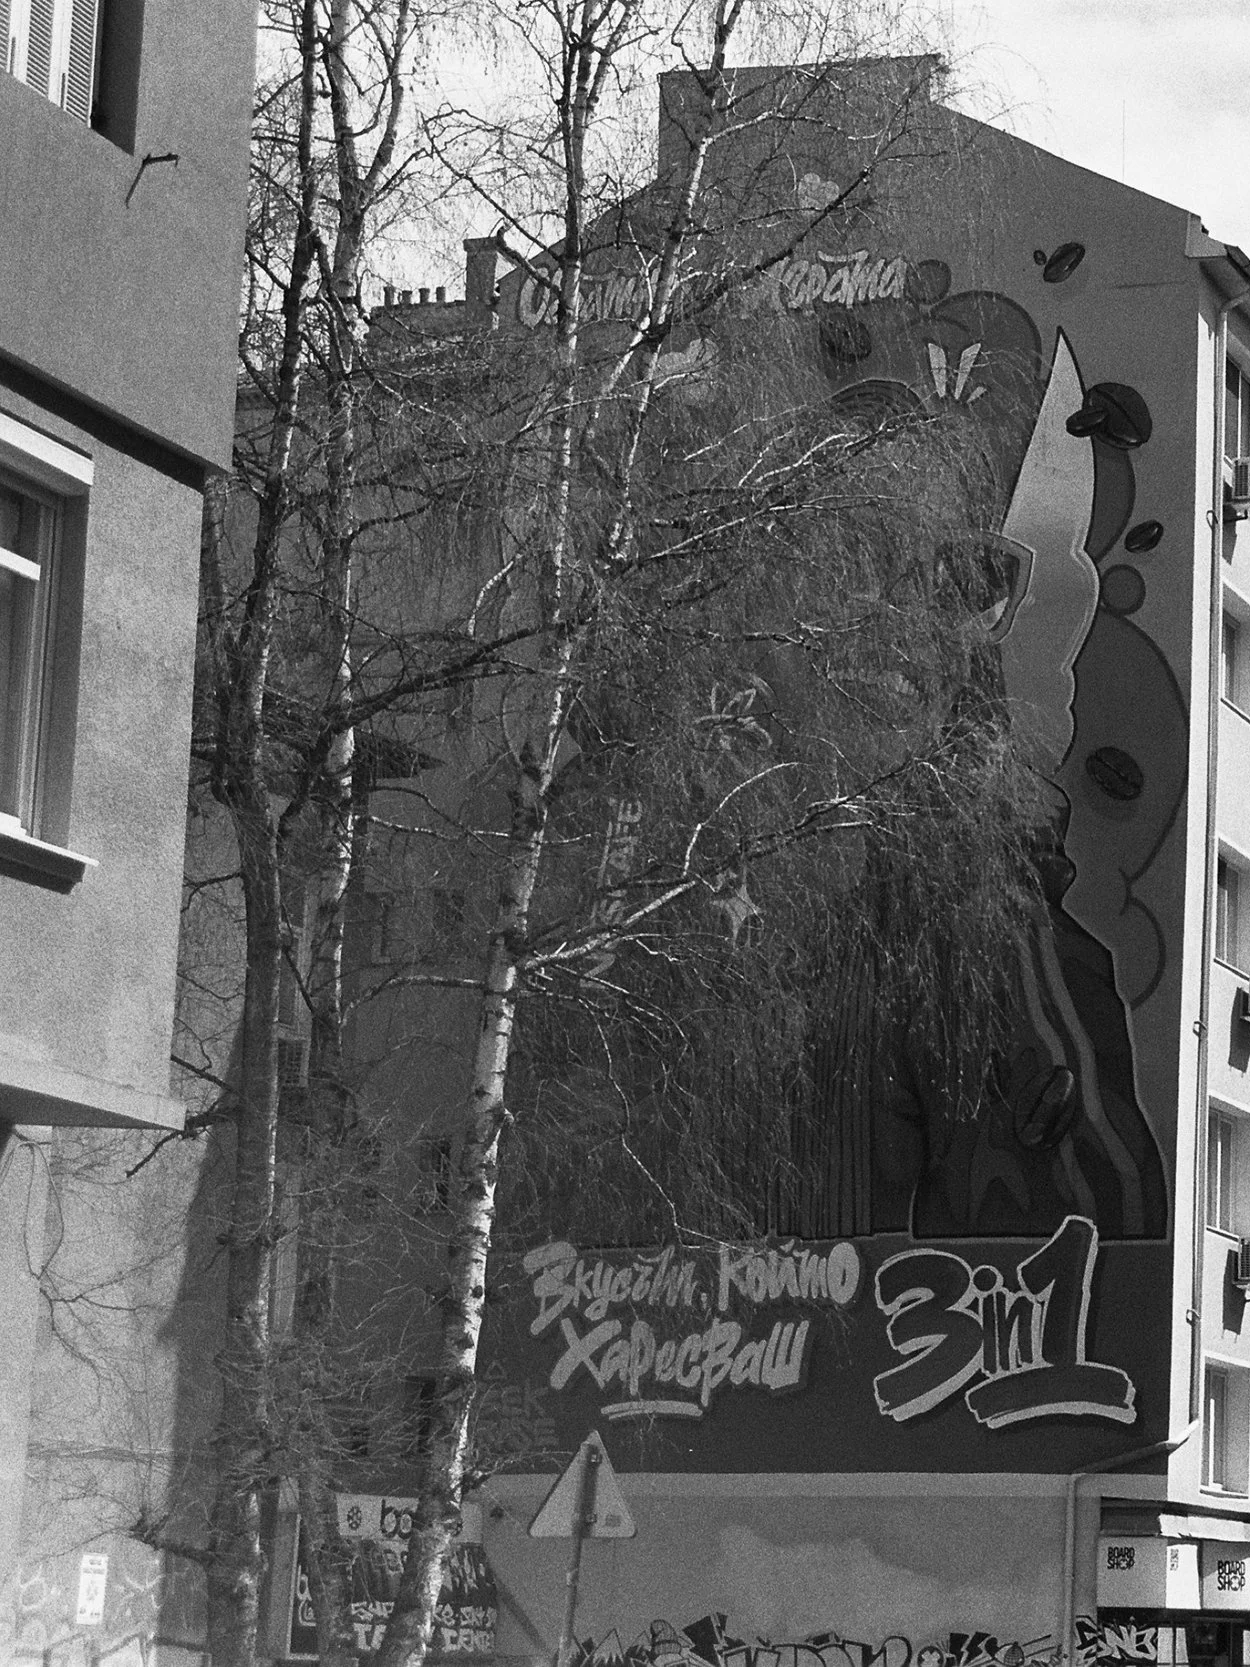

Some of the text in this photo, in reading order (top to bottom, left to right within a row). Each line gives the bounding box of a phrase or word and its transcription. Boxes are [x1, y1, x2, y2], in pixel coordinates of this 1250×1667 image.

[1107, 1547, 1135, 1559] BOARD
[1107, 1558, 1135, 1570] SHOP
[1217, 1560, 1246, 1575] BOARD
[1217, 1575, 1246, 1591] SHOP
